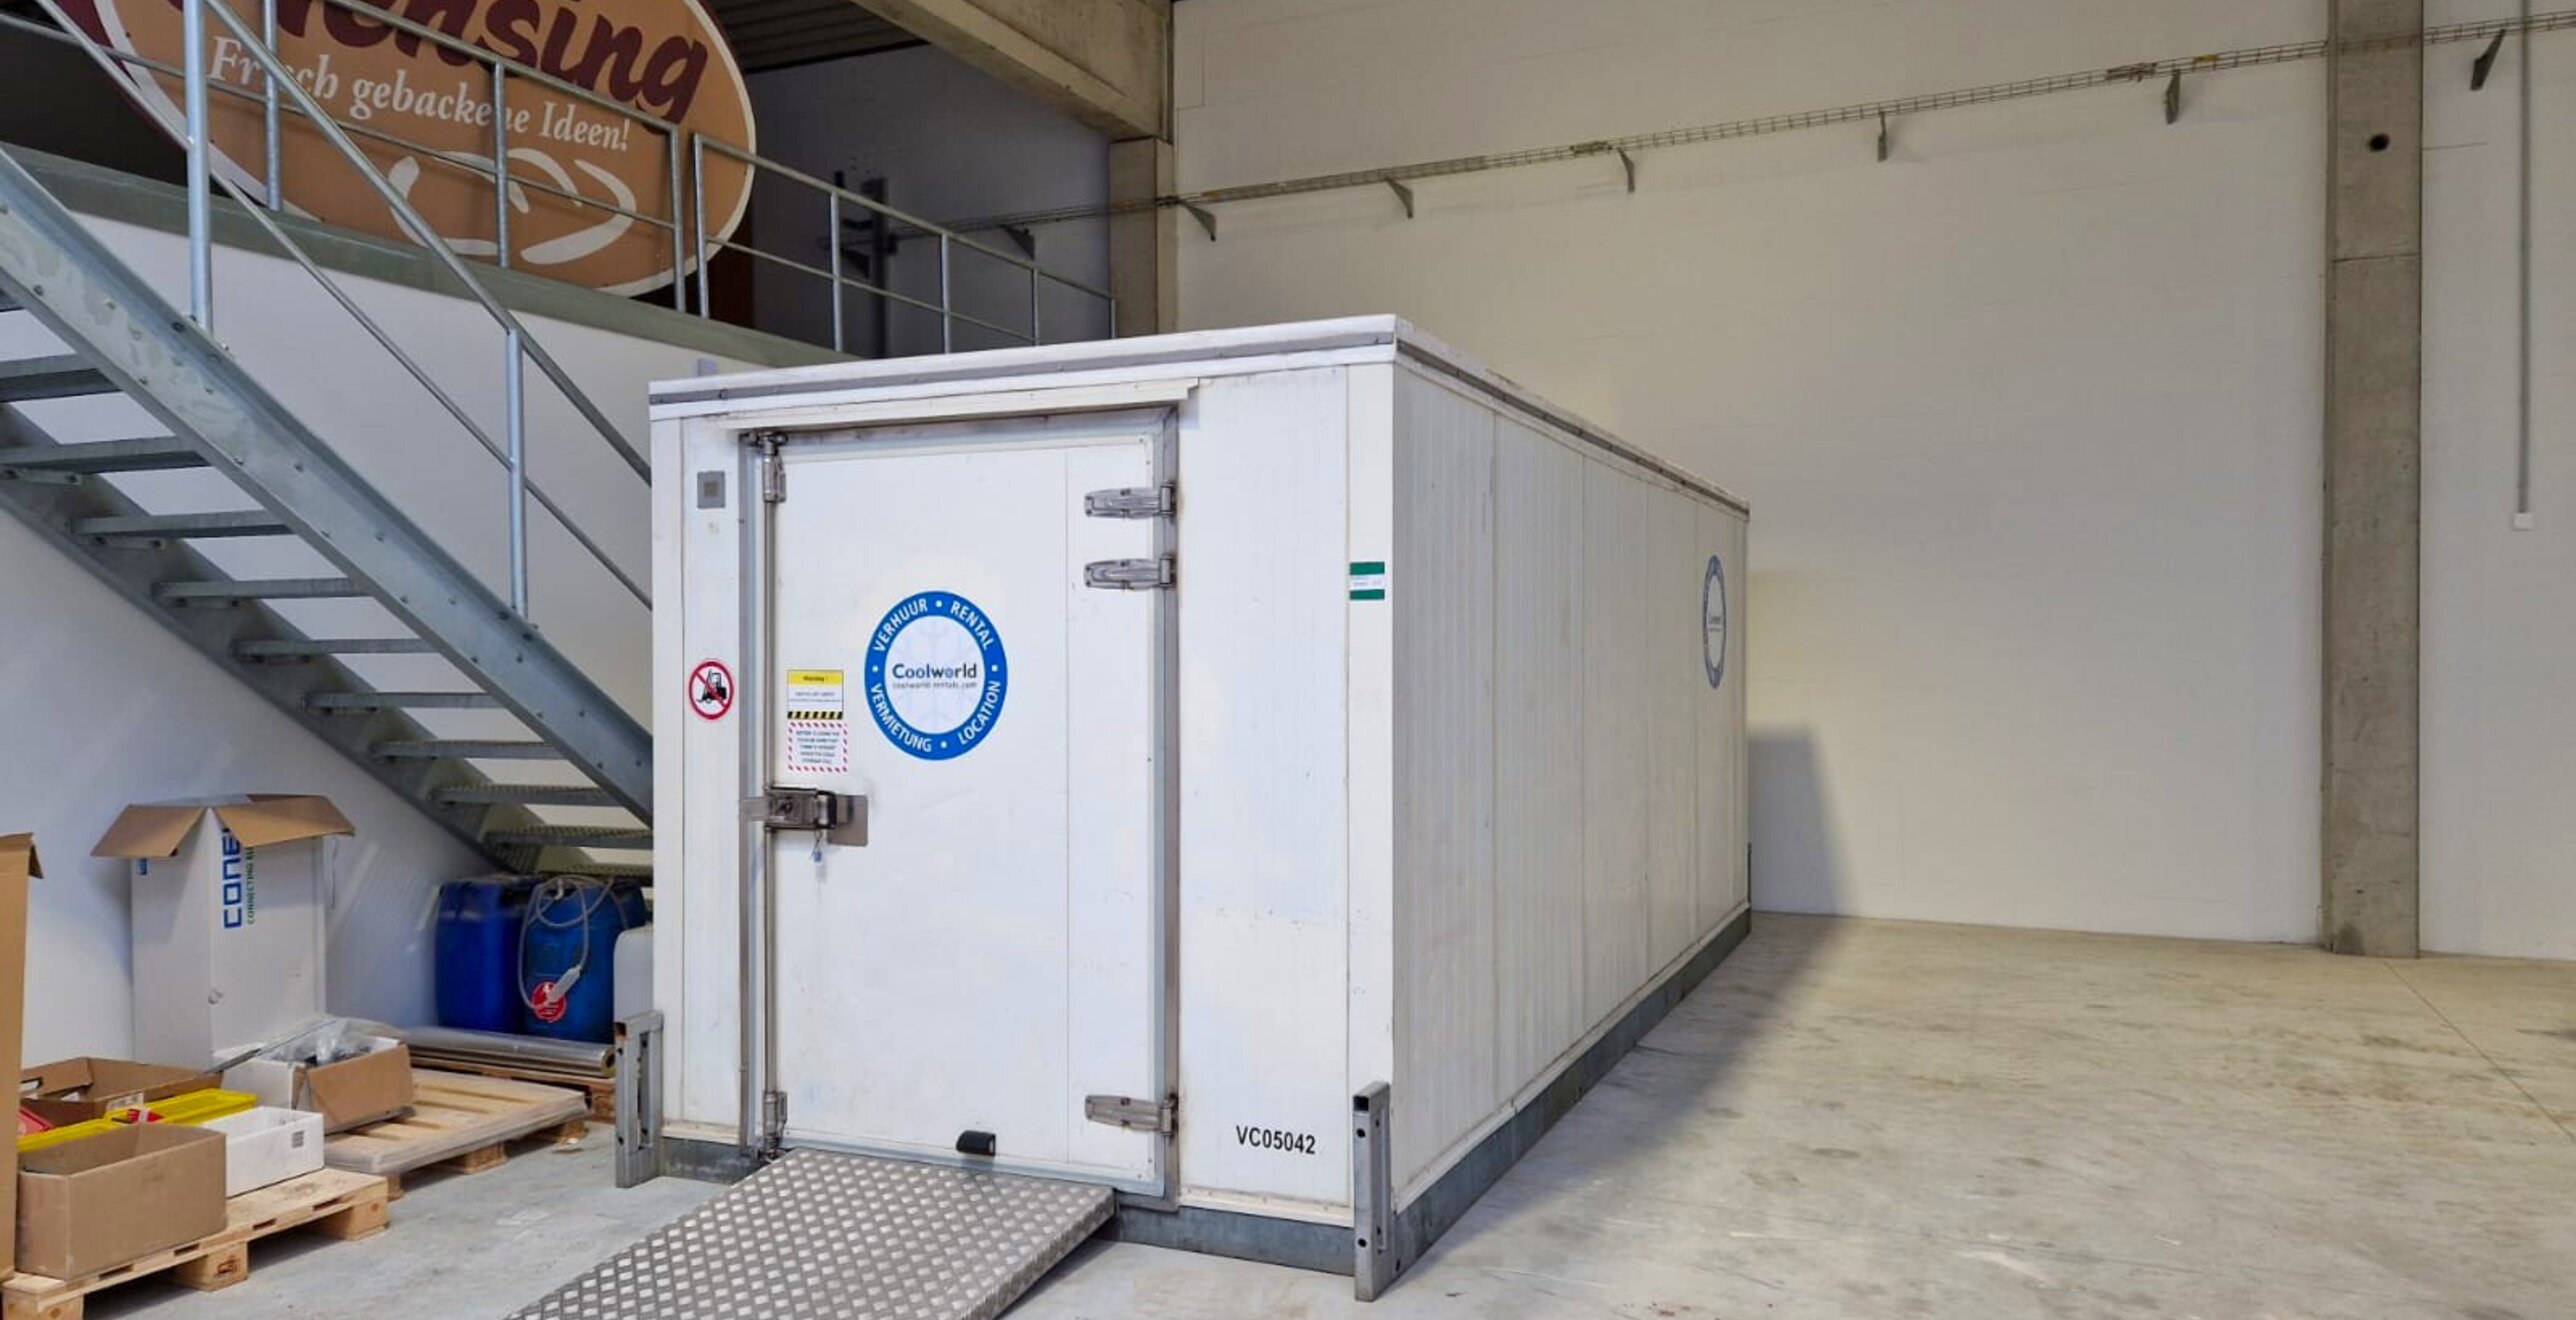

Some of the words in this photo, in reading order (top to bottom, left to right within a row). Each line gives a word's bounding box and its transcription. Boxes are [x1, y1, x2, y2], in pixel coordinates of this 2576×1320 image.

[539, 101, 630, 151] Ideen!
[873, 598, 928, 652] VERHUUR
[950, 601, 994, 650] RENTAL
[892, 663, 977, 679] Coolworld
[870, 683, 932, 753] VERMIETUNG
[957, 680, 1000, 745] LOCATION
[1236, 1125, 1316, 1155] VC05042
